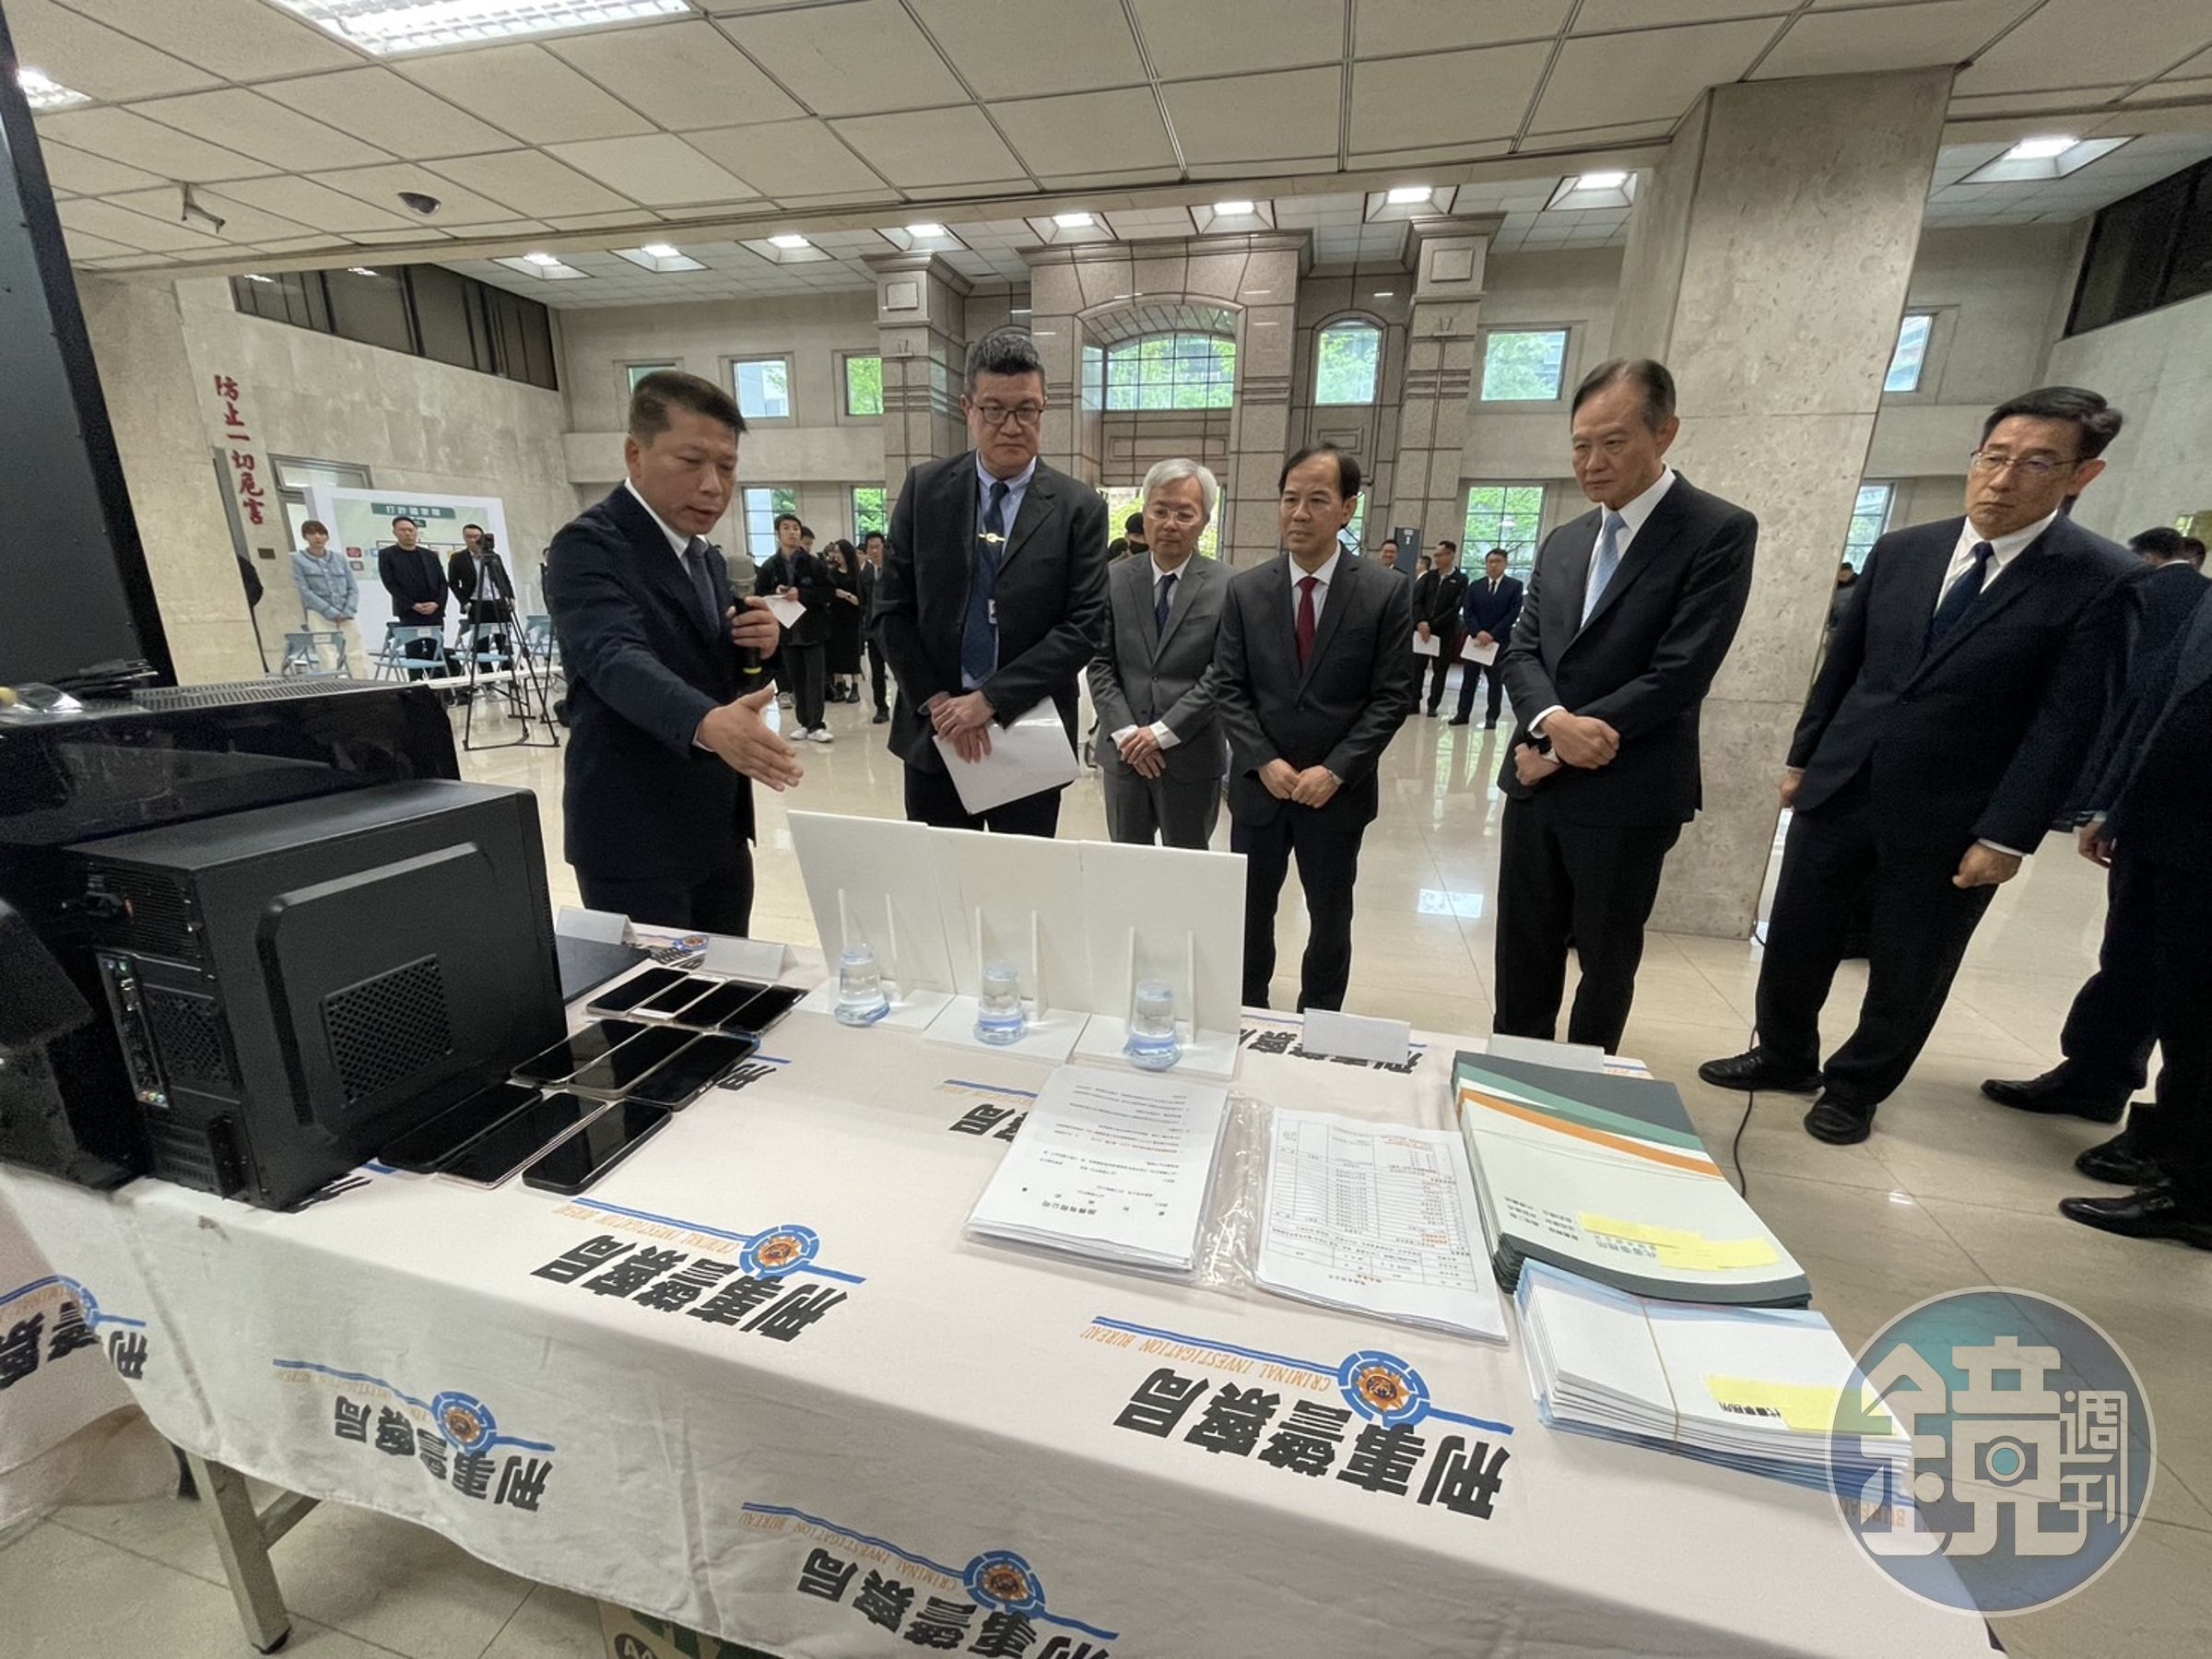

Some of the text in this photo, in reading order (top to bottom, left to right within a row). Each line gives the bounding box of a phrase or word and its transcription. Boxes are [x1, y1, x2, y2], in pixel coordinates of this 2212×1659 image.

[215, 374, 265, 524] 防止一切危害
[529, 1235, 848, 1343] 刑事警察局
[1079, 1325, 1332, 1393] CRIMINAL INVESTIGATION BUREAU
[1112, 1368, 1510, 1521] 刑事警察局
[794, 1523, 891, 1565] INVESTIGATION
[896, 1560, 959, 1592] CRIMINAL
